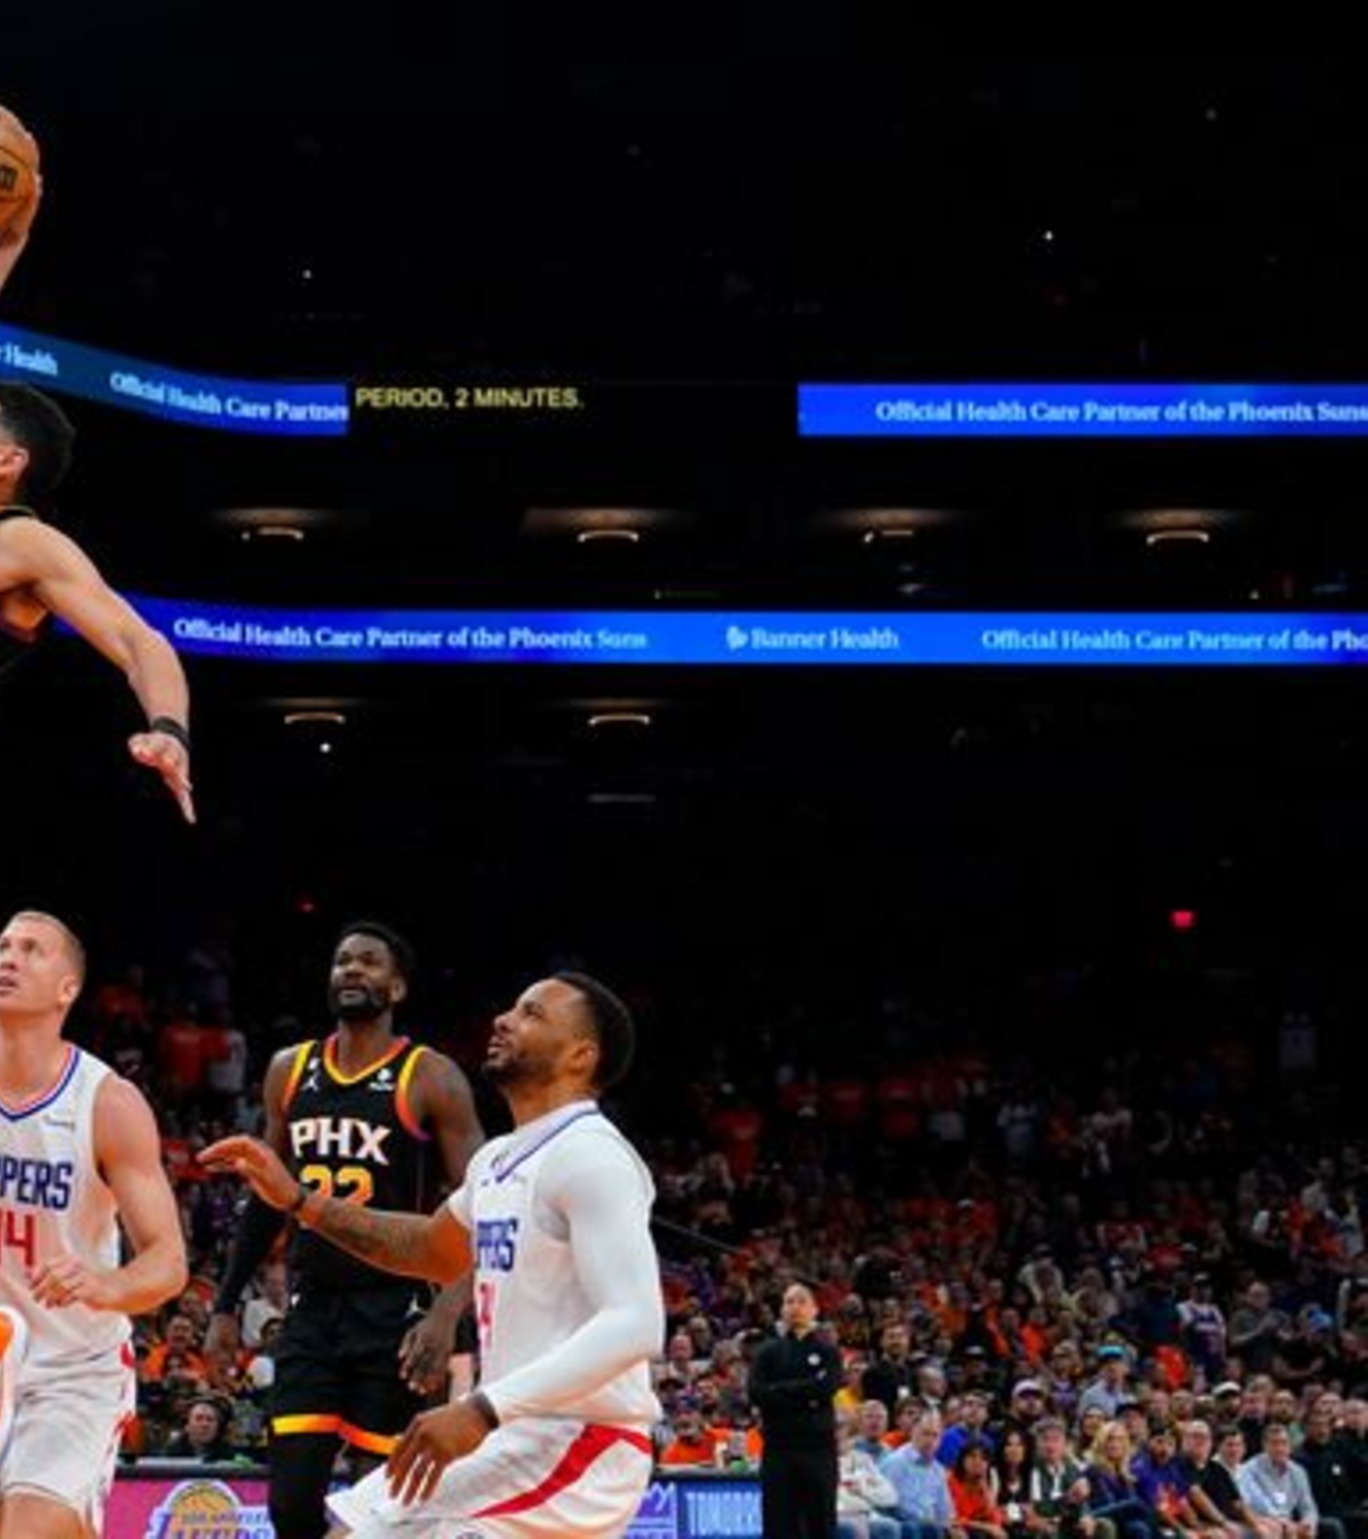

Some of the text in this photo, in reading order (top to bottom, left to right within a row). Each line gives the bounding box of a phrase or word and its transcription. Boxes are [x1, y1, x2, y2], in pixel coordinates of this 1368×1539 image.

[5, 342, 58, 375] Health
[110, 373, 166, 403] Official
[167, 387, 222, 414] Health
[225, 398, 271, 418] Care
[355, 388, 584, 410] PERIOD, 2 MINUTES.
[876, 401, 952, 421] Official
[957, 401, 1027, 421] Health
[1030, 402, 1080, 421] Care
[1083, 402, 1160, 421] Partner
[1164, 400, 1191, 421] of
[1191, 401, 1225, 421] the
[1228, 400, 1314, 421] Phoenix
[174, 619, 647, 648] Official Health Care Partner of the Phoenix Suns
[751, 628, 899, 649] Banner Health
[982, 630, 1057, 649] Official
[1062, 630, 1131, 649] Health
[1135, 631, 1184, 649] Care
[1188, 630, 1264, 649] Partner
[1268, 629, 1290, 649] of
[1293, 630, 1328, 650] the
[289, 1115, 391, 1166] PHX
